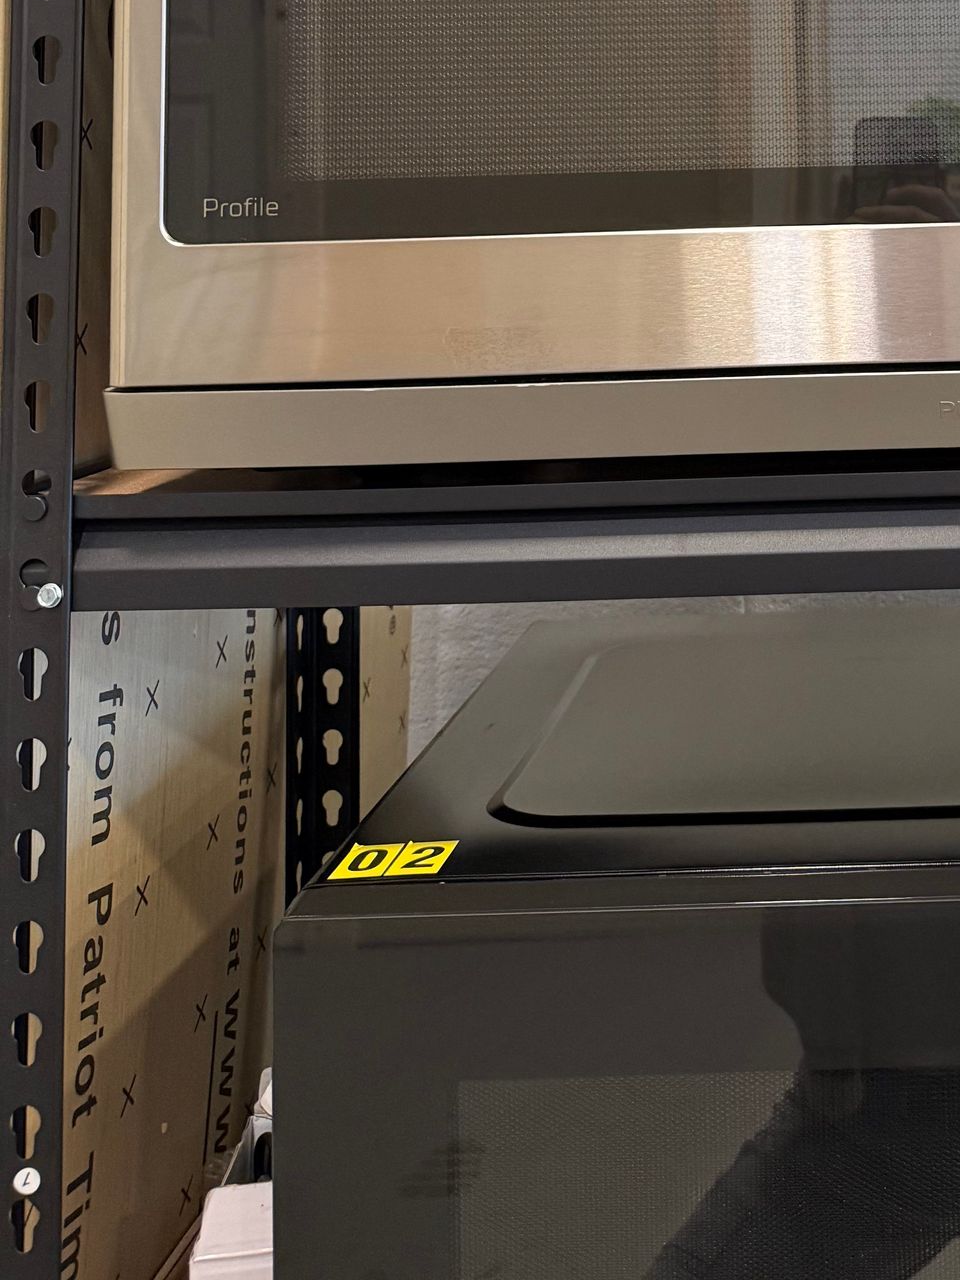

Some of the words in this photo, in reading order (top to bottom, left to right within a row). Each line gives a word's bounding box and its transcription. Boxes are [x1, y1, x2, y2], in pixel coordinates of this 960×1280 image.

[203, 197, 279, 218] Profile
[91, 683, 124, 846] from
[227, 927, 241, 976] at
[71, 882, 114, 1129] Patriot
